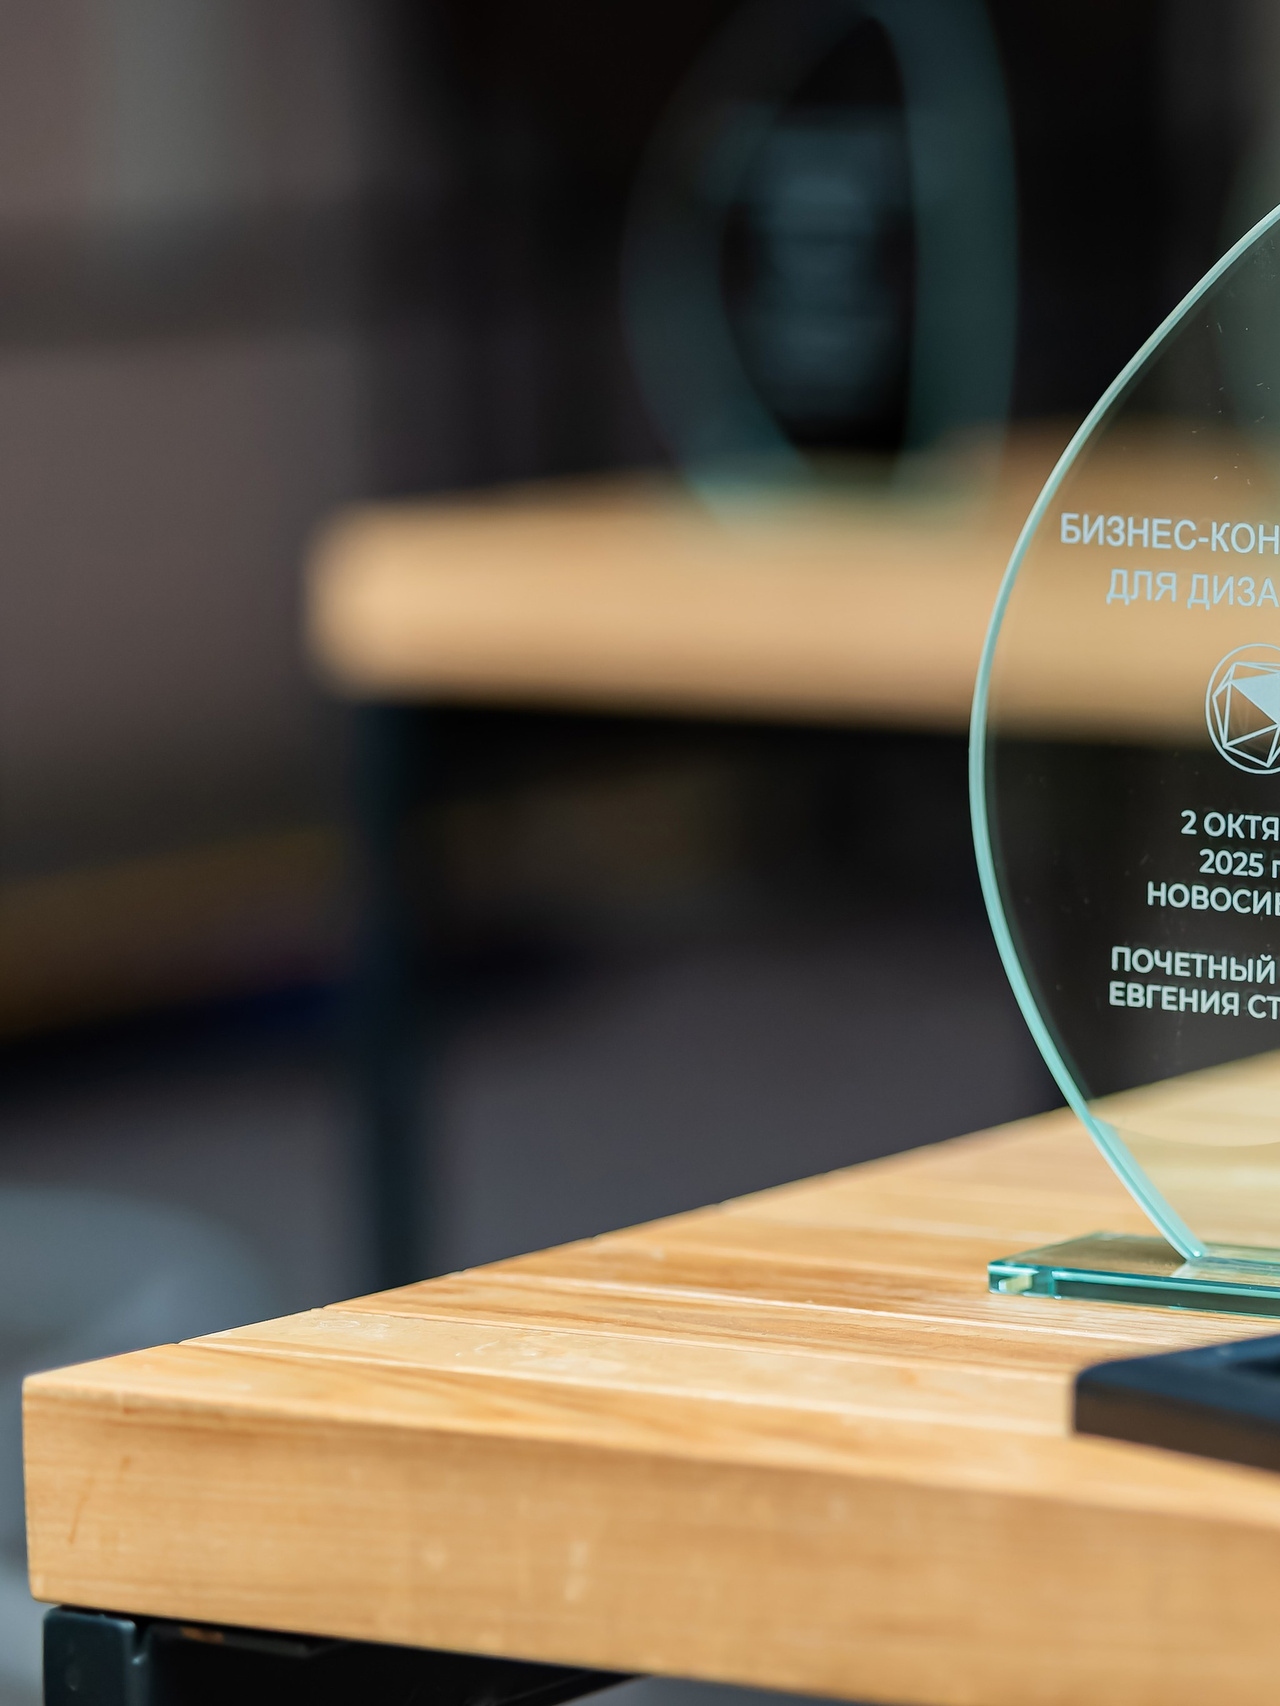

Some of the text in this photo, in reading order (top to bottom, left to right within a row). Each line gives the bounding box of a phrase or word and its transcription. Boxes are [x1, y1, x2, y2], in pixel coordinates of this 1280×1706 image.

[1106, 568, 1178, 605] ДЛЯ
[1180, 809, 1197, 835] 2
[1199, 848, 1264, 878] 2025
[1111, 946, 1276, 985] ПОЧЕТНЫЙ
[1108, 981, 1240, 1017] ЕВГЕНИЯ
